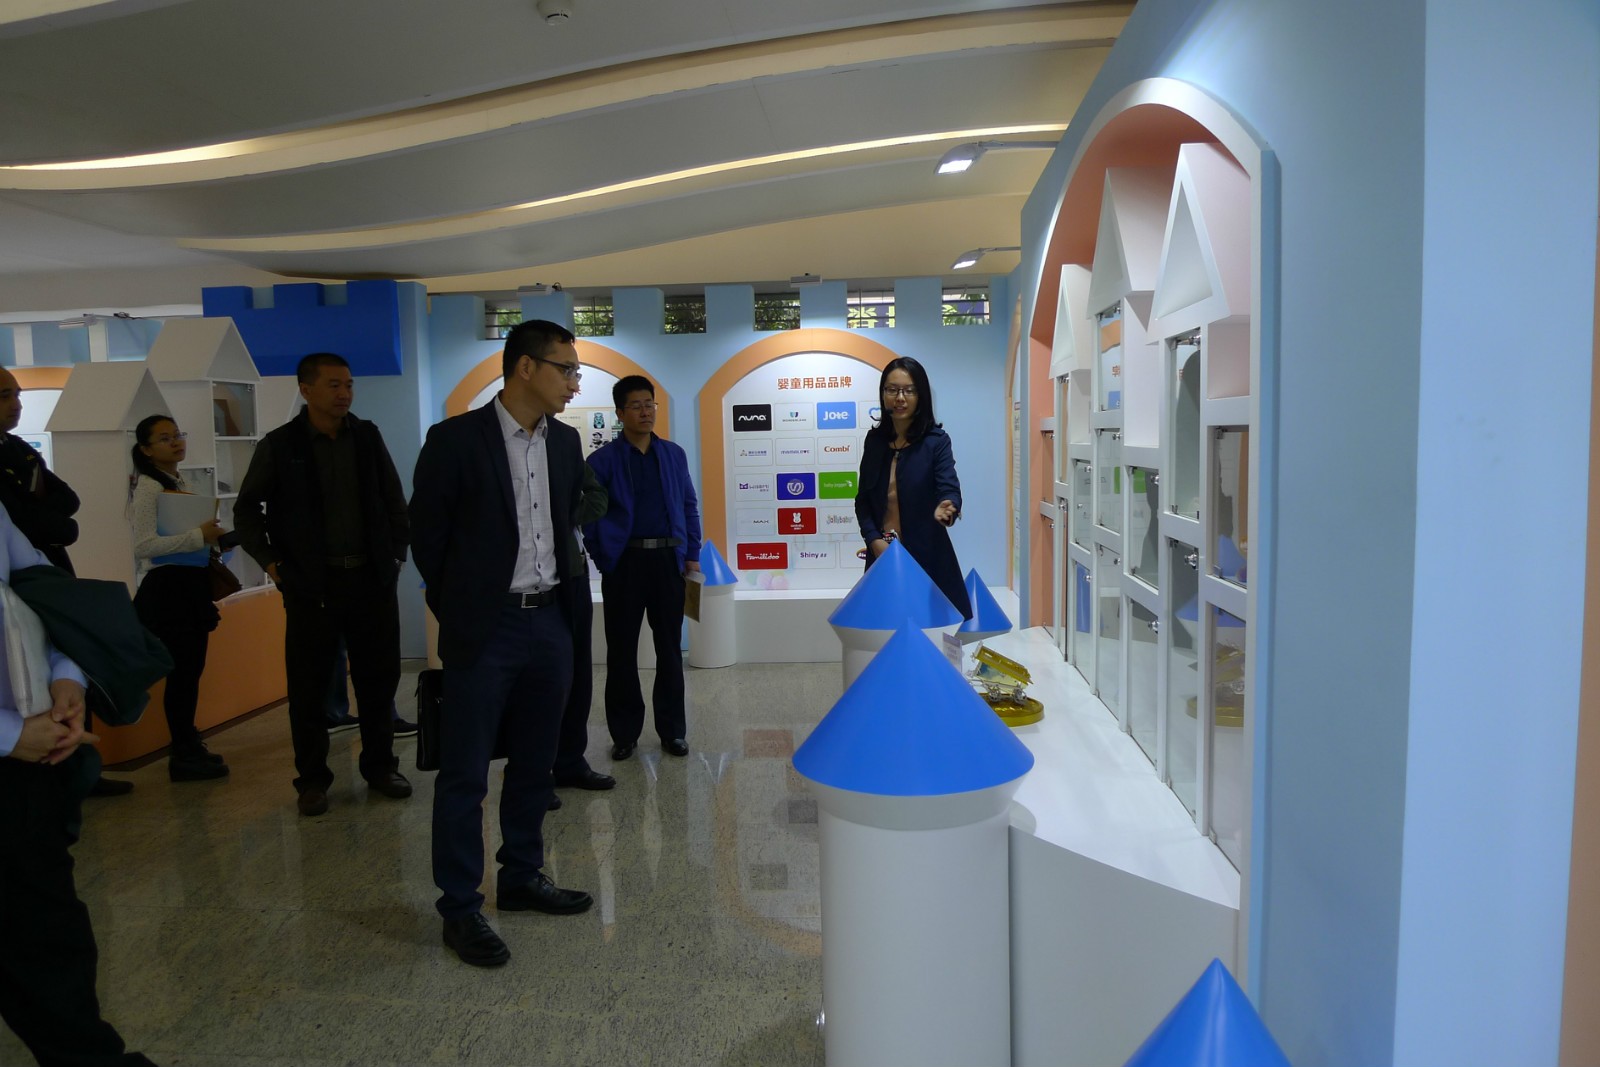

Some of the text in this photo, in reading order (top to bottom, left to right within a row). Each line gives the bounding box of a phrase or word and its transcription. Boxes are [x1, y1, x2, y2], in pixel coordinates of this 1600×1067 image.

[777, 376, 852, 390] 婴童用品品牌
[824, 445, 850, 453] Combi
